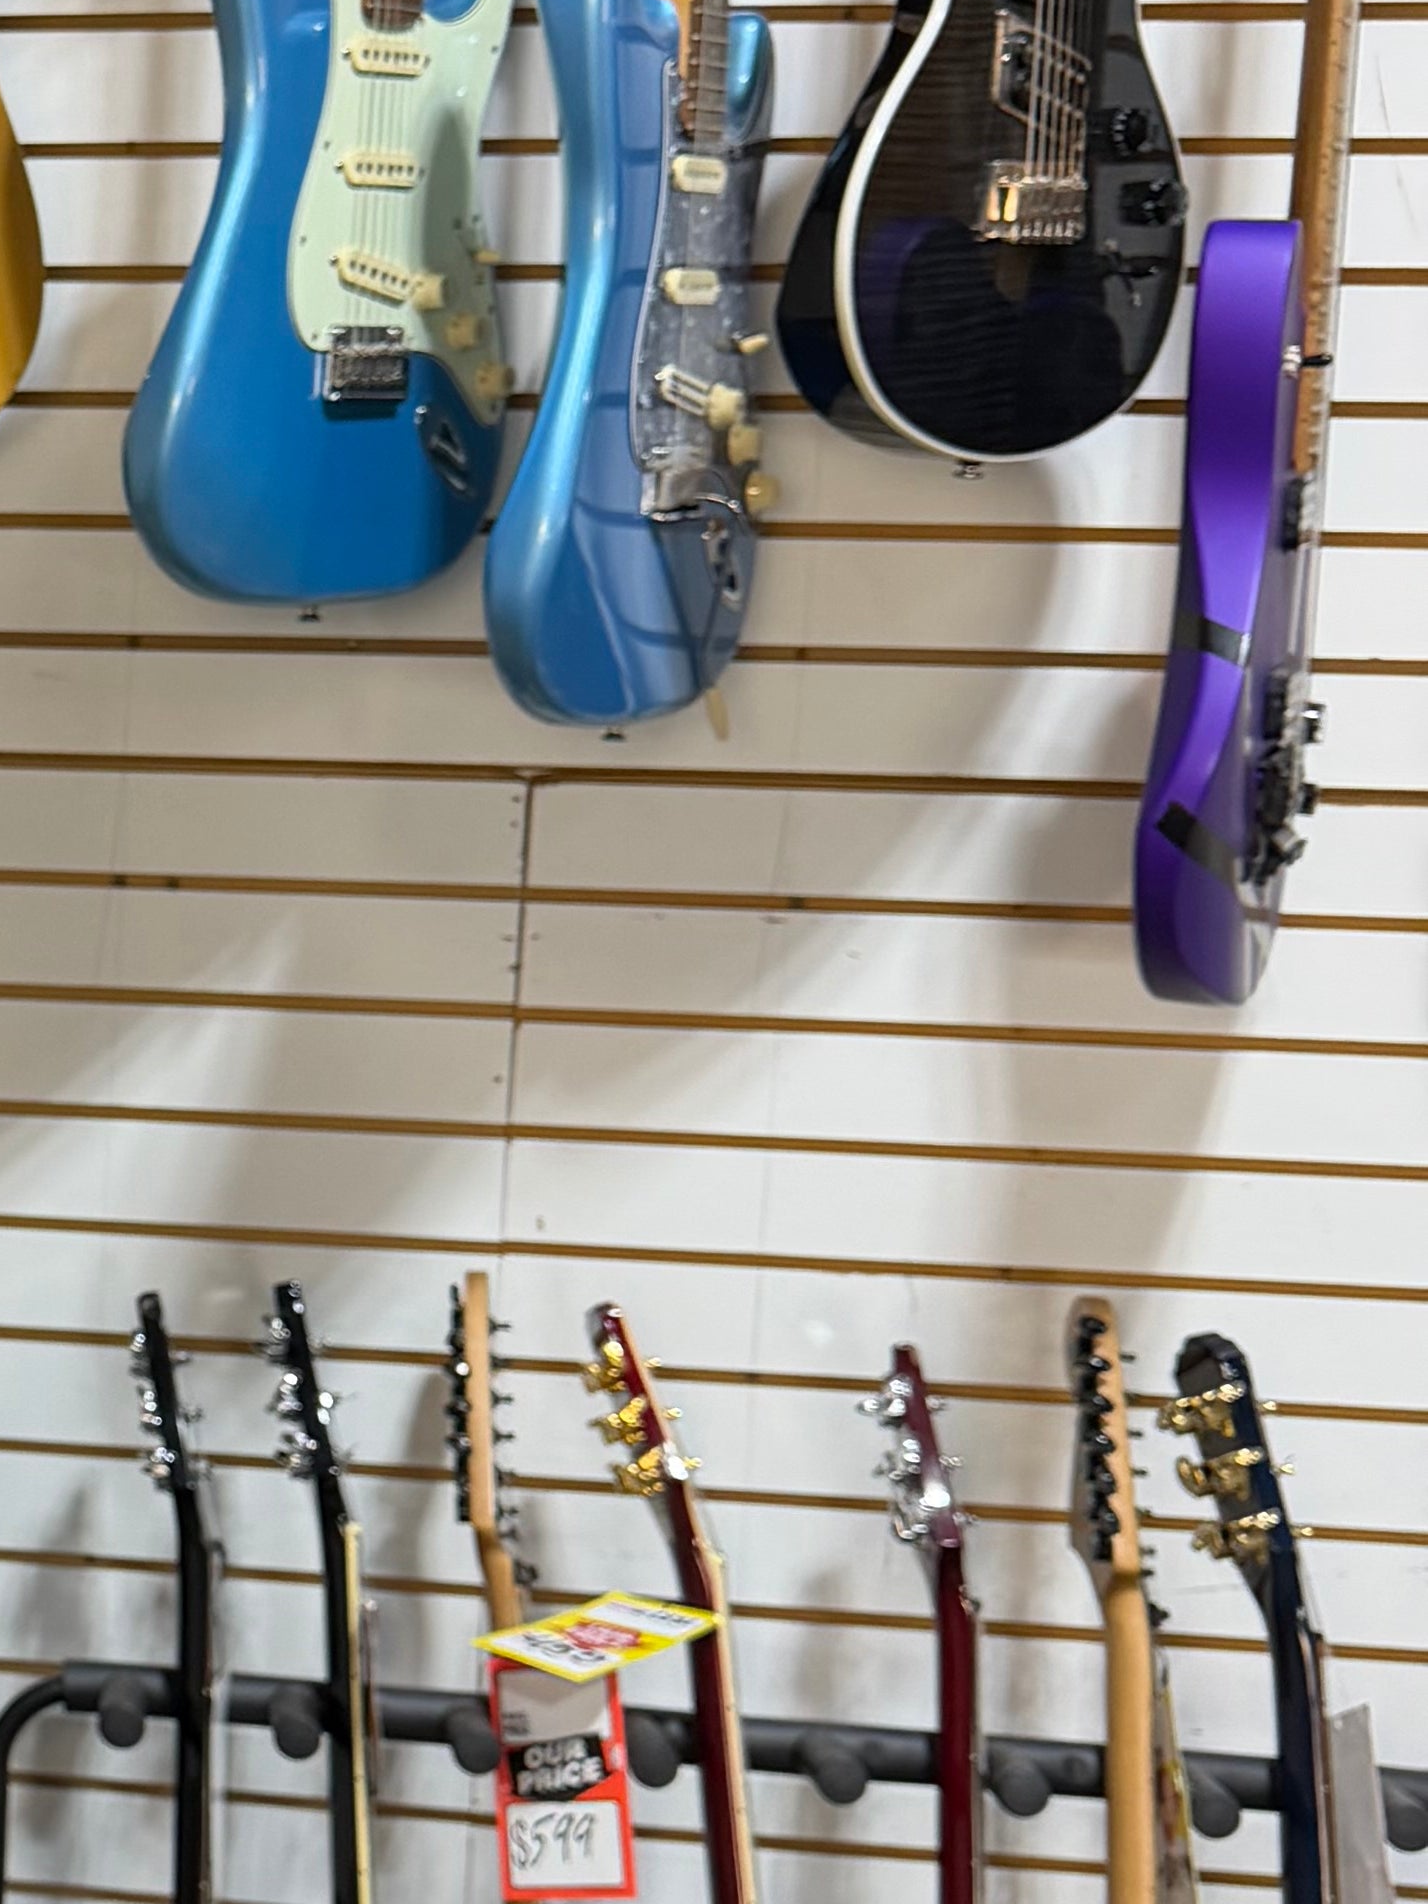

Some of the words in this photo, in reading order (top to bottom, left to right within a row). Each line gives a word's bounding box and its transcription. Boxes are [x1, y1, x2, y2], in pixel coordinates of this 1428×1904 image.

[523, 1737, 588, 1770] OUR
[516, 1757, 606, 1796] PRICE
[509, 1811, 596, 1871] $599
